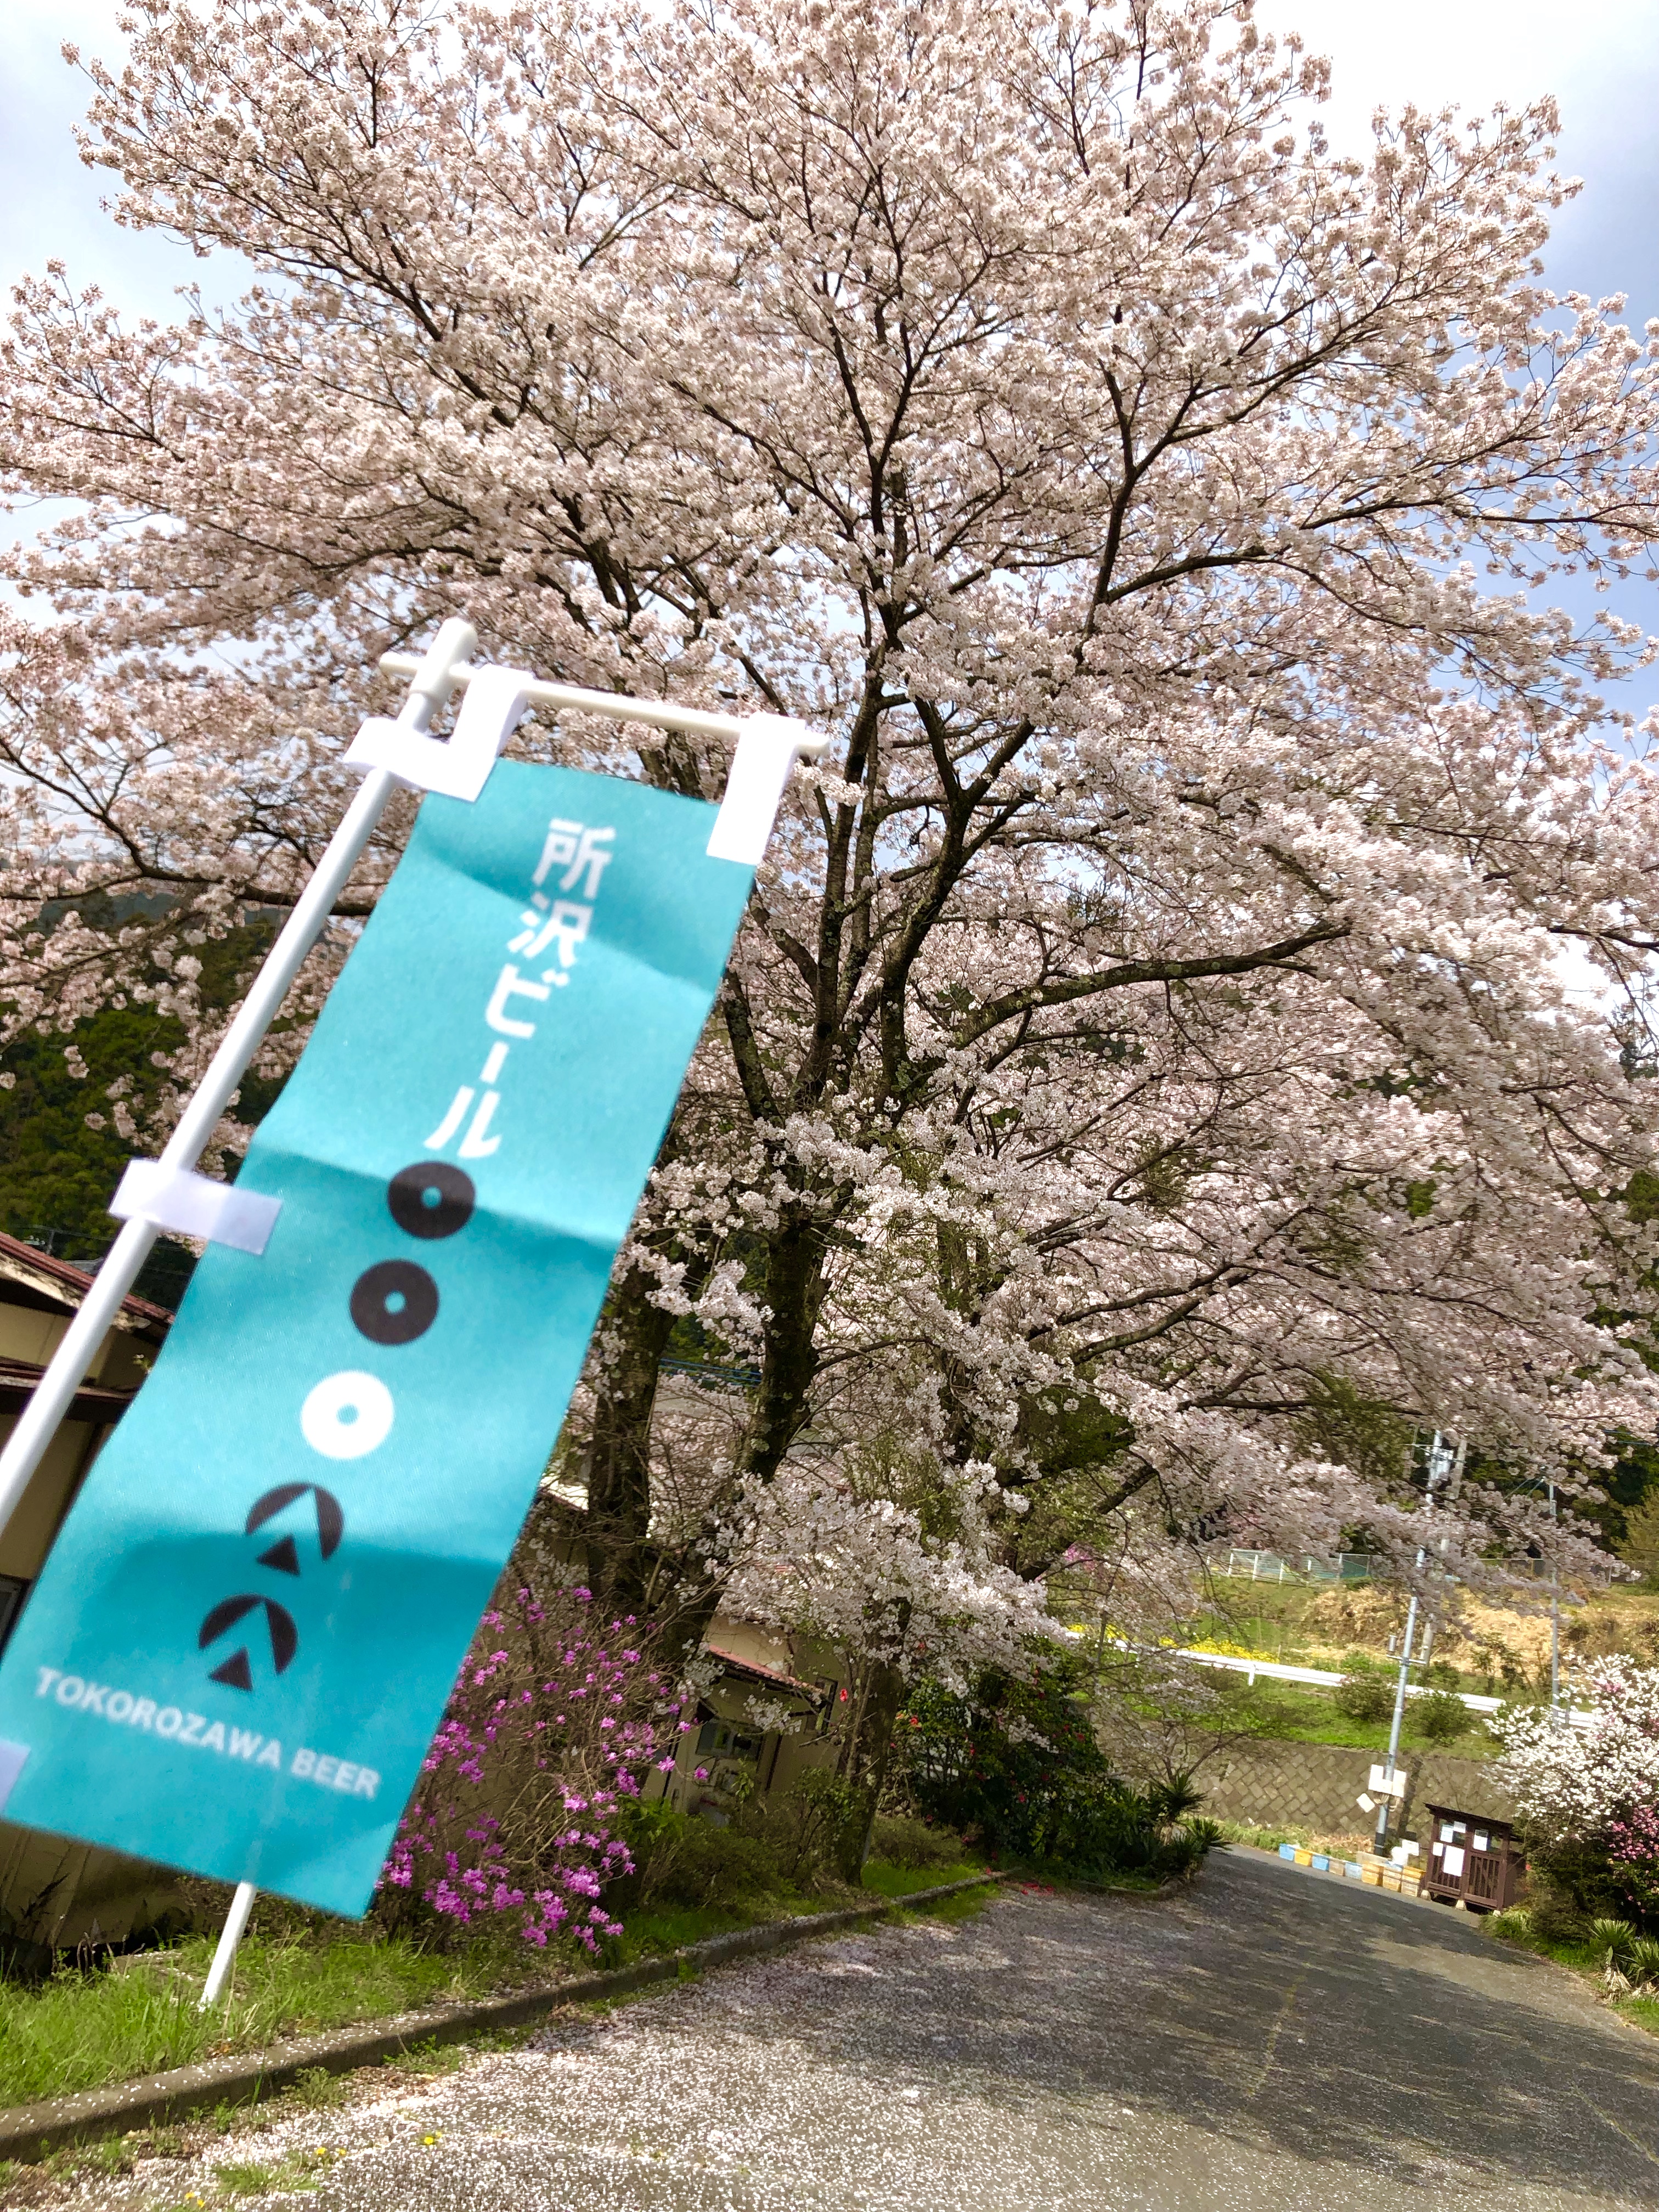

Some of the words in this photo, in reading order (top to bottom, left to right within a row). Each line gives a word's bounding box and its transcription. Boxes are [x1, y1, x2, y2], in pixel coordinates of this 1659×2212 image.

[424, 817, 616, 1159] 所沢ビール
[35, 1667, 282, 1769] TOKOROZAWA
[291, 1748, 382, 1800] BEER
